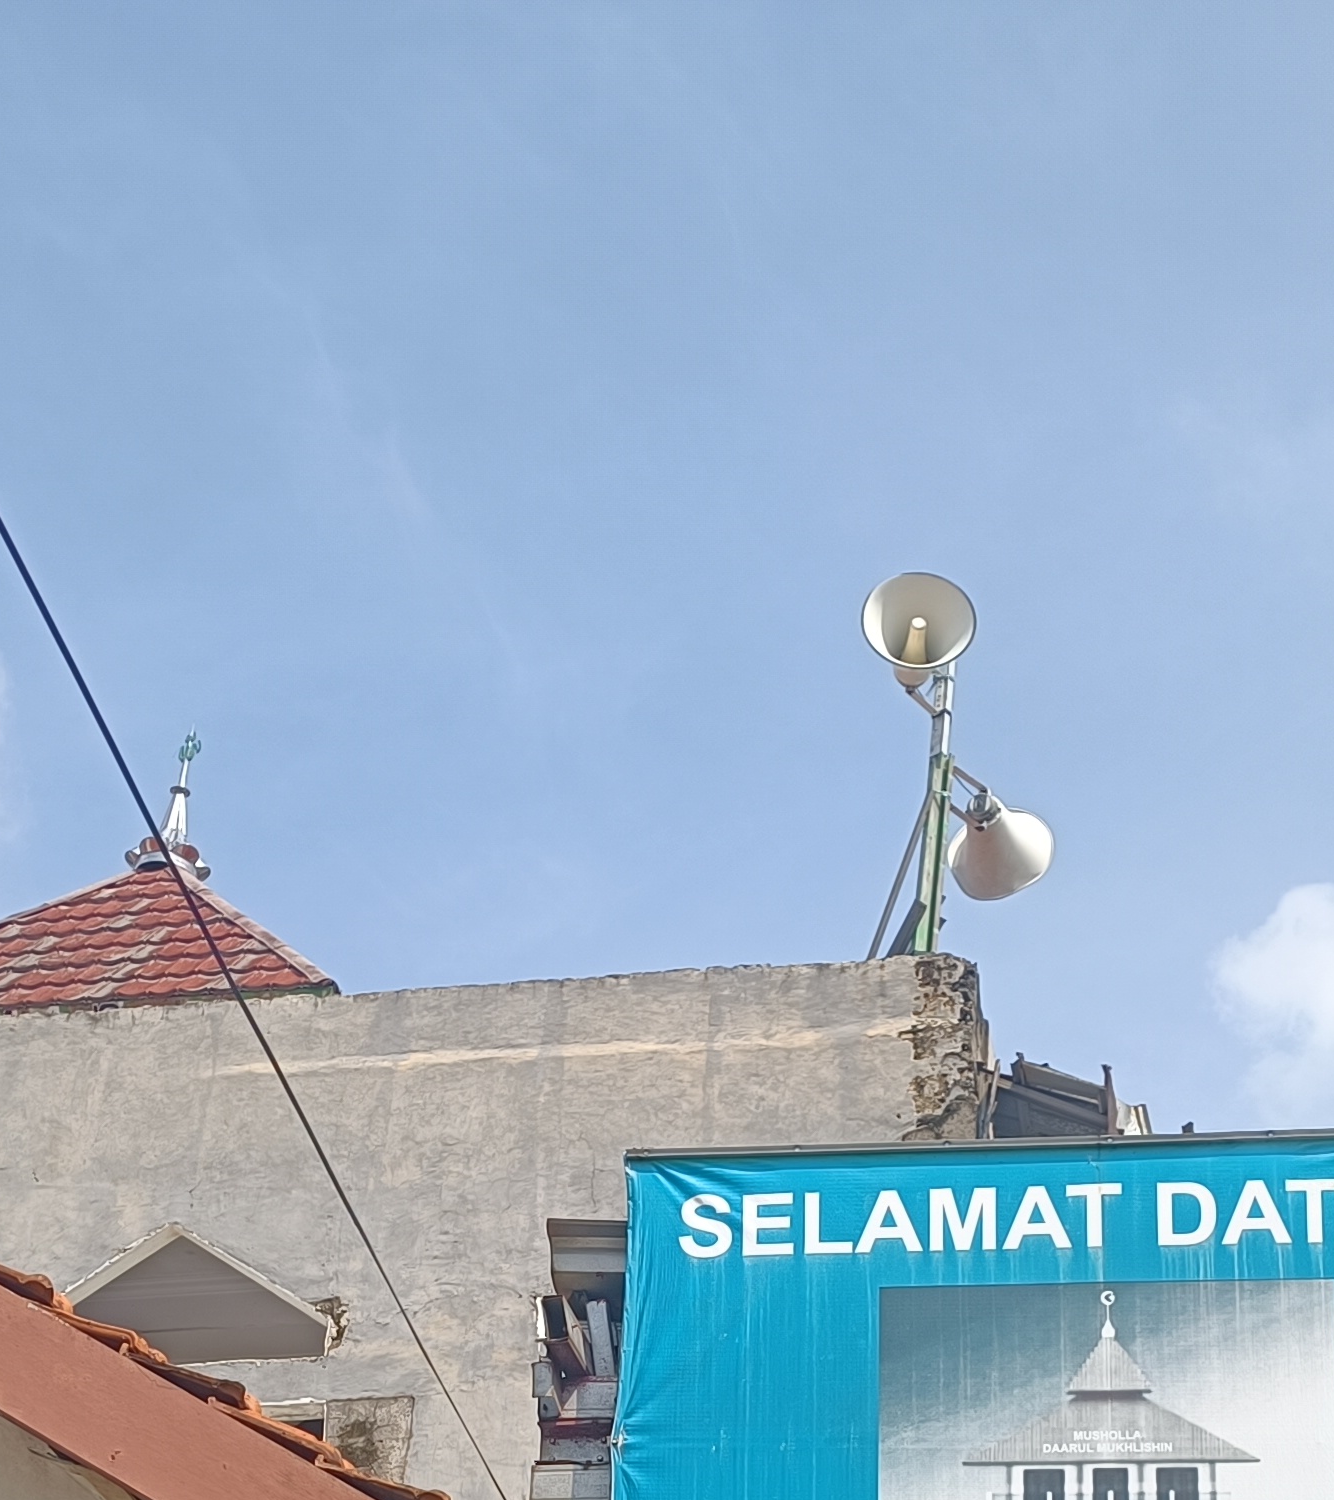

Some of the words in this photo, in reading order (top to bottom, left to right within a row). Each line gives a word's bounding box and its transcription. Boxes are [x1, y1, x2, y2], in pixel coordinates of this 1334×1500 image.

[678, 1184, 1122, 1258] SELAMAT
[1073, 1430, 1141, 1441] MUSHOLLA
[1042, 1443, 1094, 1453] DAARUL
[1096, 1442, 1173, 1453] MUKHLISHIN
